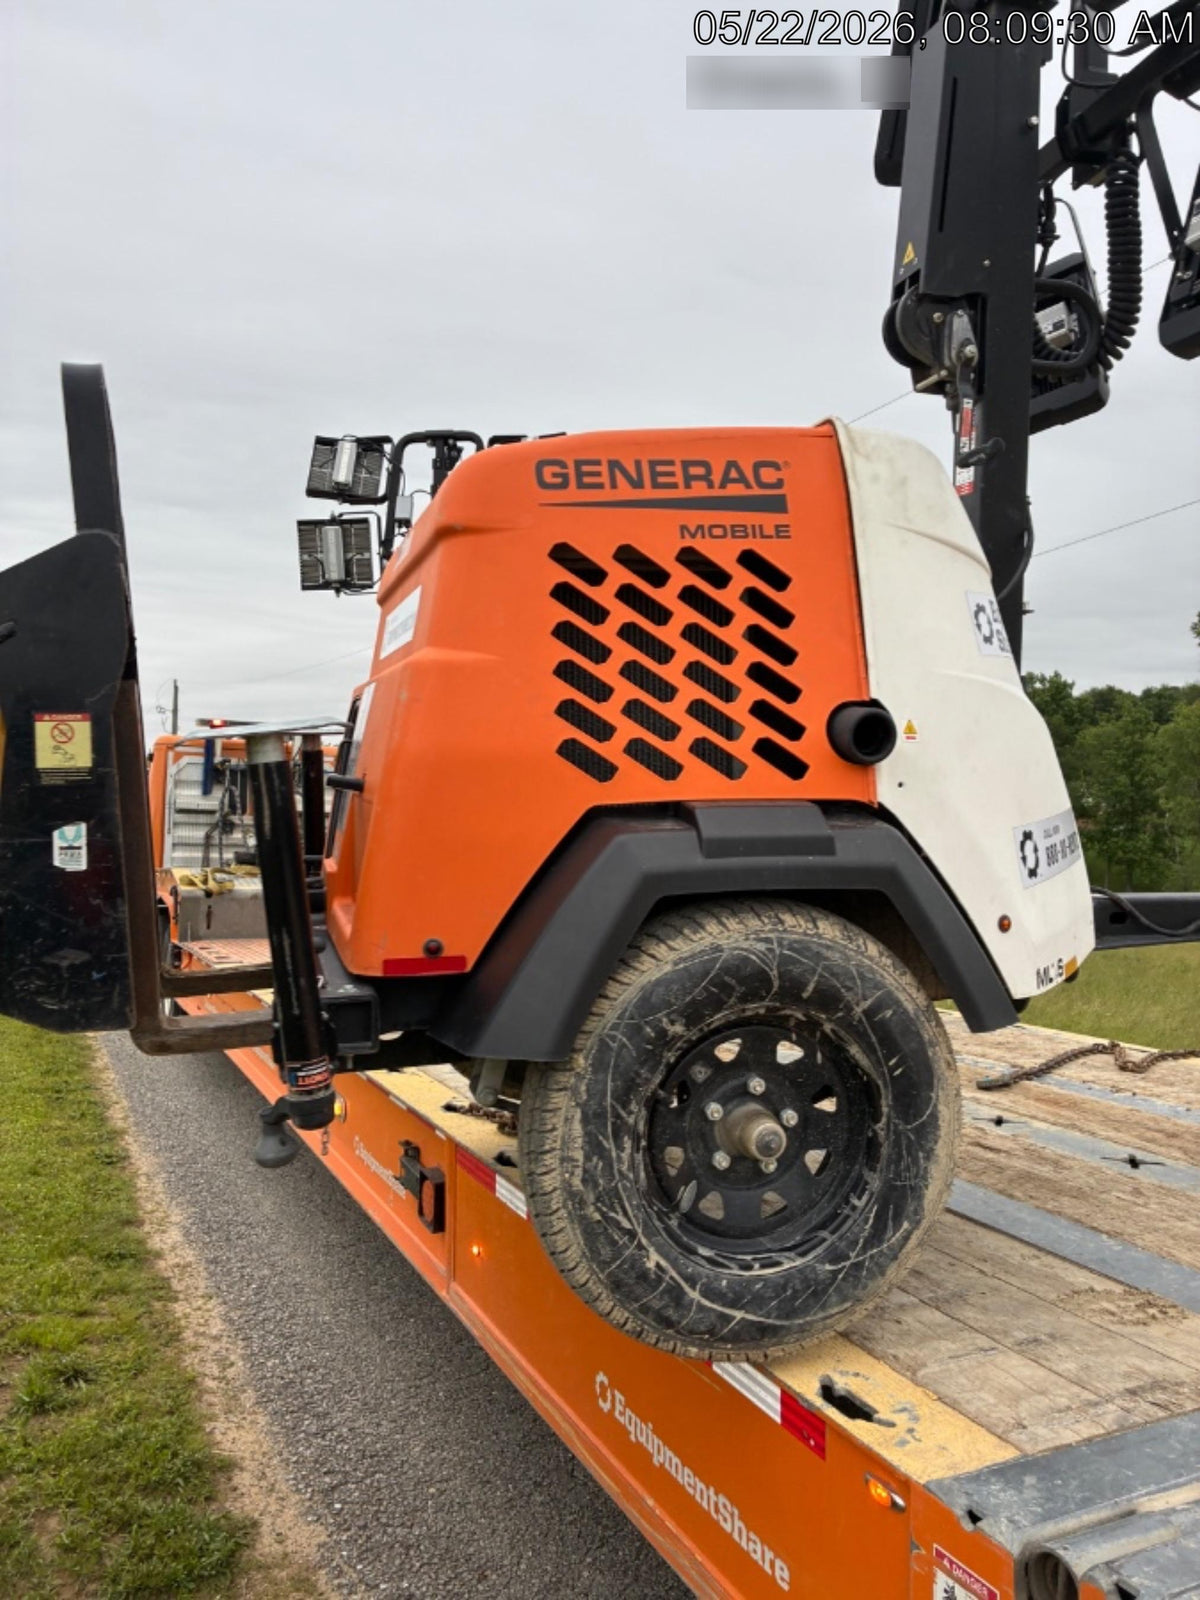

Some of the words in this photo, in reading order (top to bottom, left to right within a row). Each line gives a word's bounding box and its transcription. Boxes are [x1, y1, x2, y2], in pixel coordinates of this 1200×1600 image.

[534, 458, 785, 490] GENERAC
[679, 524, 791, 539] MOBILE
[614, 1389, 790, 1592] EquipmentShare
